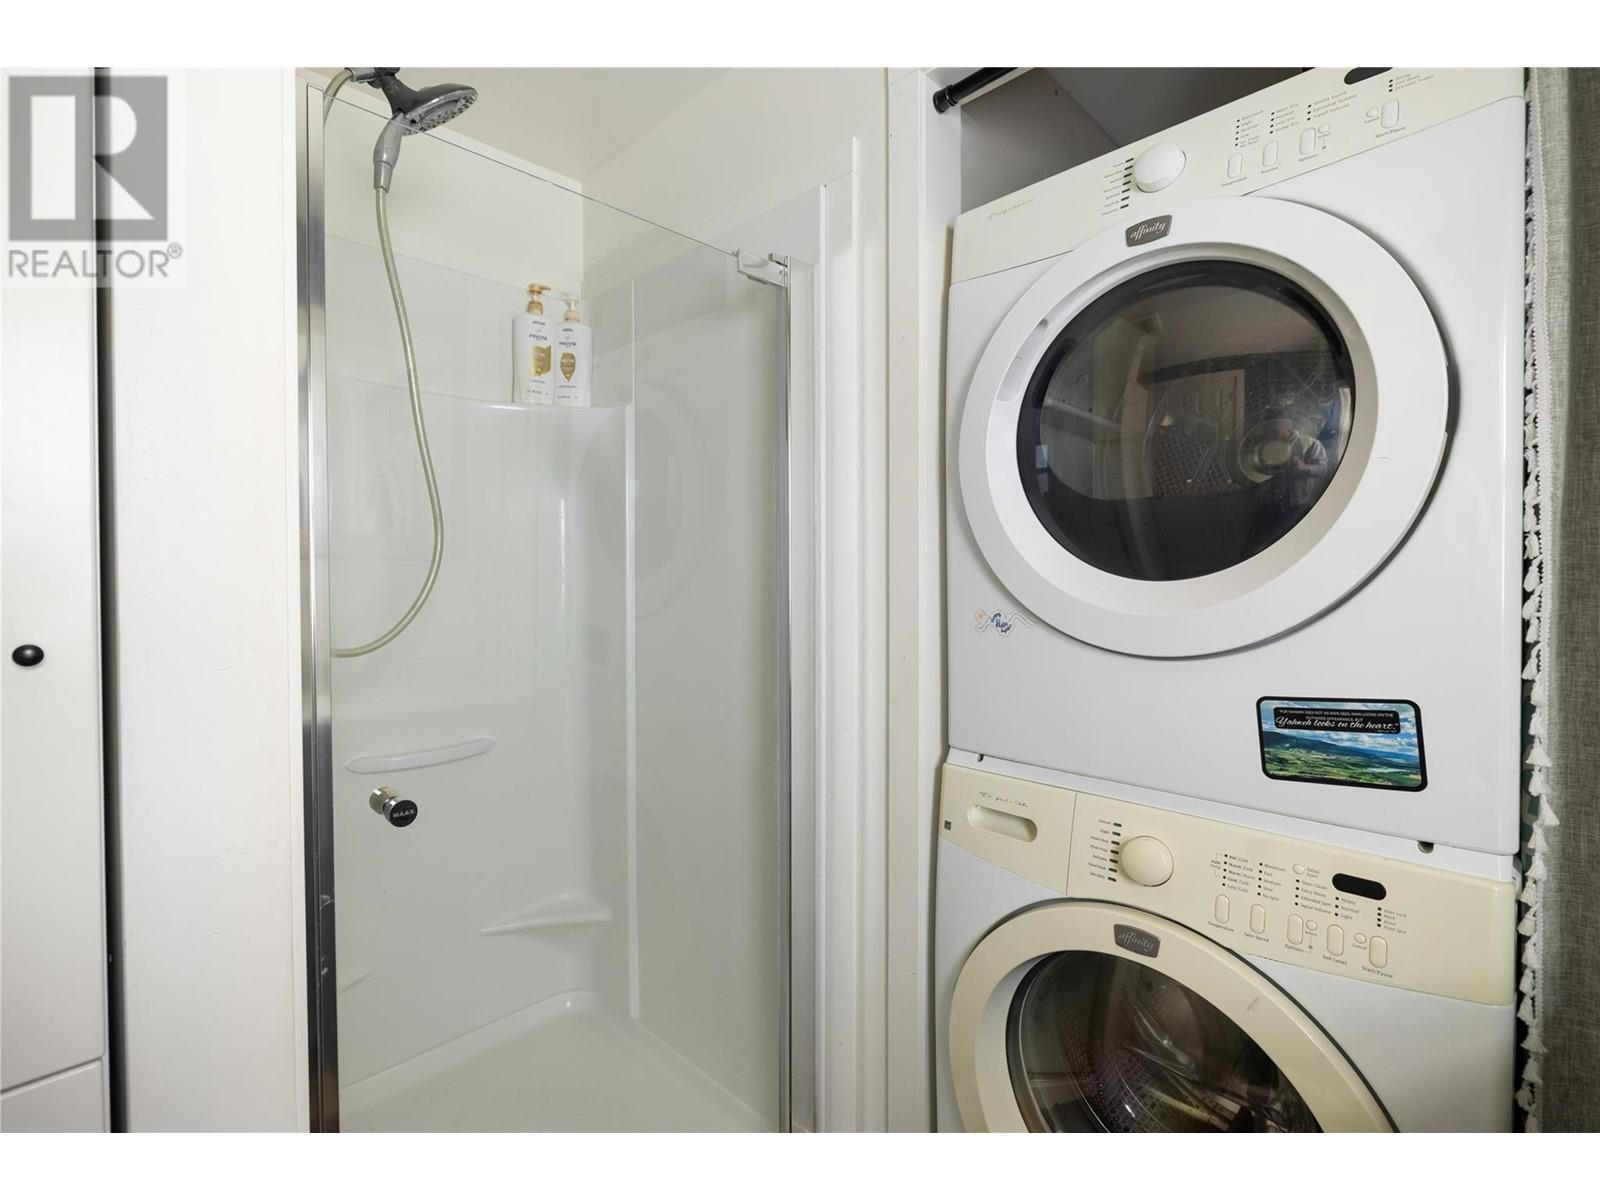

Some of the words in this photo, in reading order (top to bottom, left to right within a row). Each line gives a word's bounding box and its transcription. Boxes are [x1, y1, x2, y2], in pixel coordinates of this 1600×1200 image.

[1130, 221, 1167, 241] affinity
[1275, 716, 1312, 728] Yahweh
[1313, 719, 1336, 728] looks
[1350, 720, 1365, 729] the
[392, 808, 415, 818] MAAX
[1118, 930, 1155, 953] affinity
